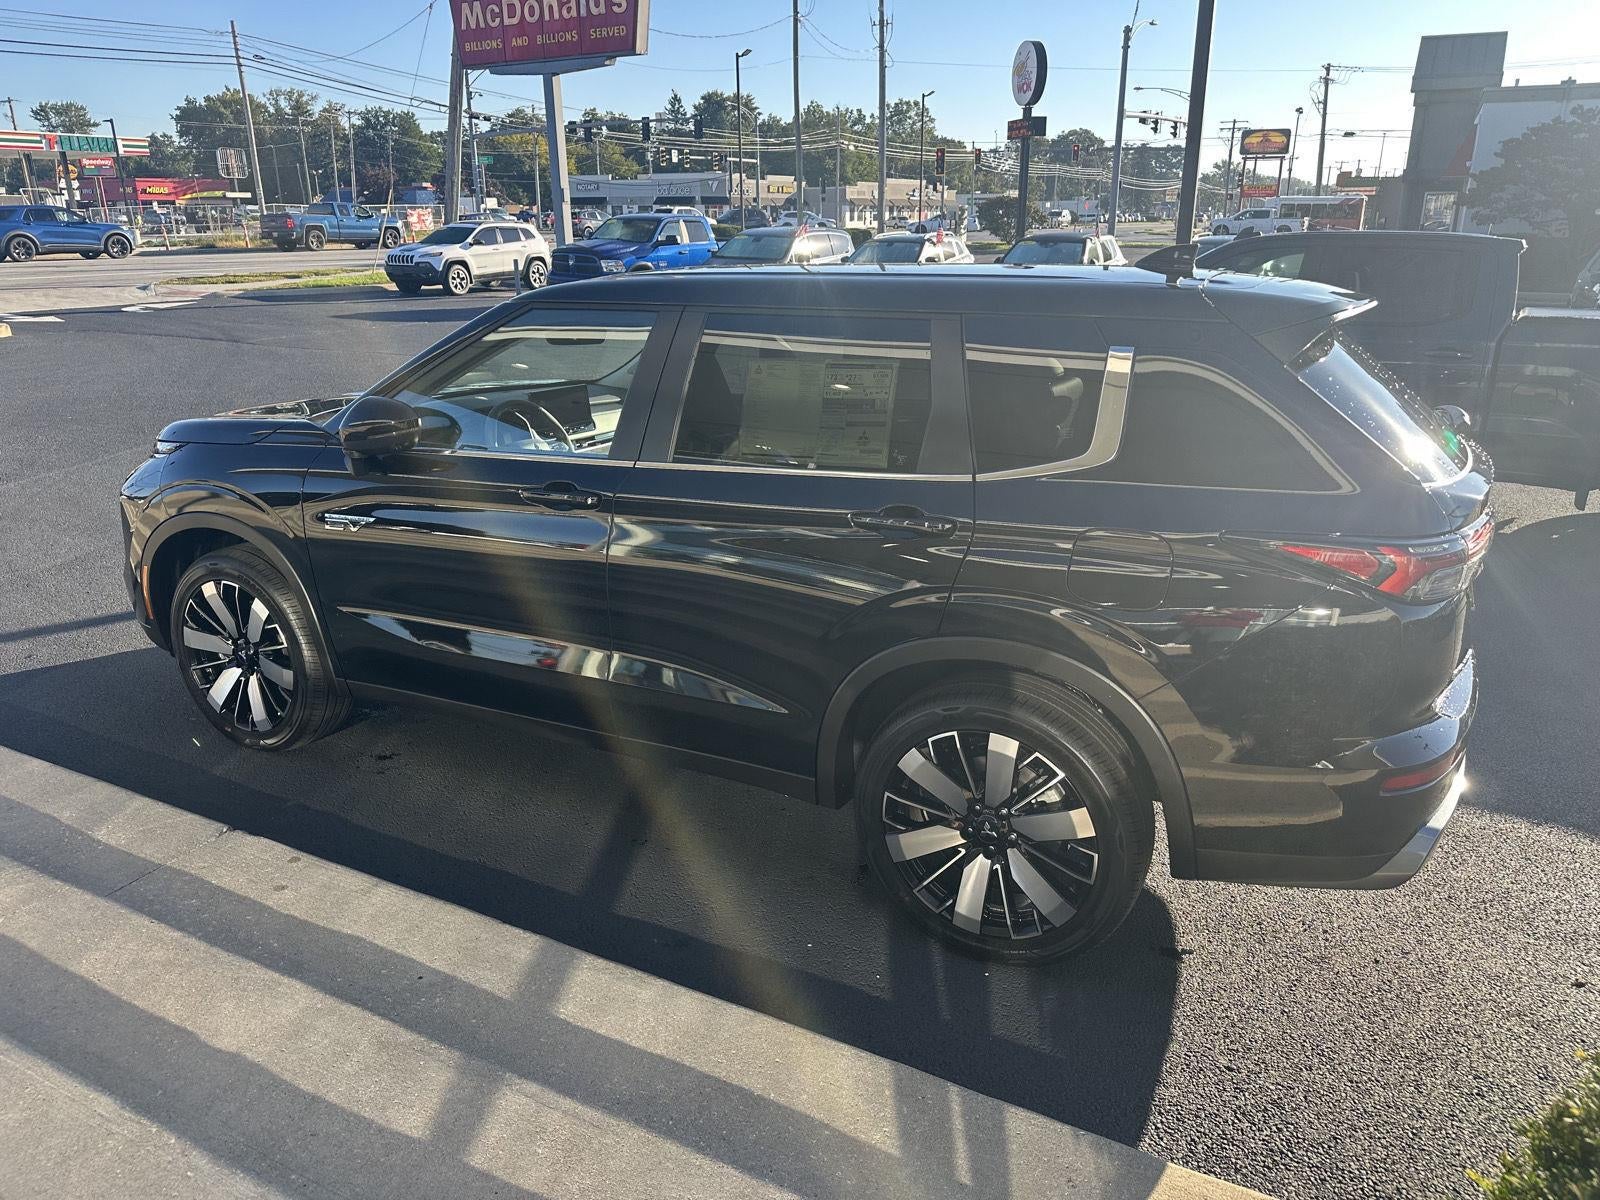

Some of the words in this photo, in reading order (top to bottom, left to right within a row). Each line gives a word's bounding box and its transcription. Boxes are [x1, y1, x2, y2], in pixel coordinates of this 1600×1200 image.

[461, 0, 627, 30] McDonalds
[464, 39, 503, 52] BILLIONS
[511, 36, 529, 47] AND
[536, 31, 578, 44] BILLIONS
[589, 25, 627, 39] SERVED
[82, 158, 111, 167] Speedway
[577, 183, 599, 192] NOTARY
